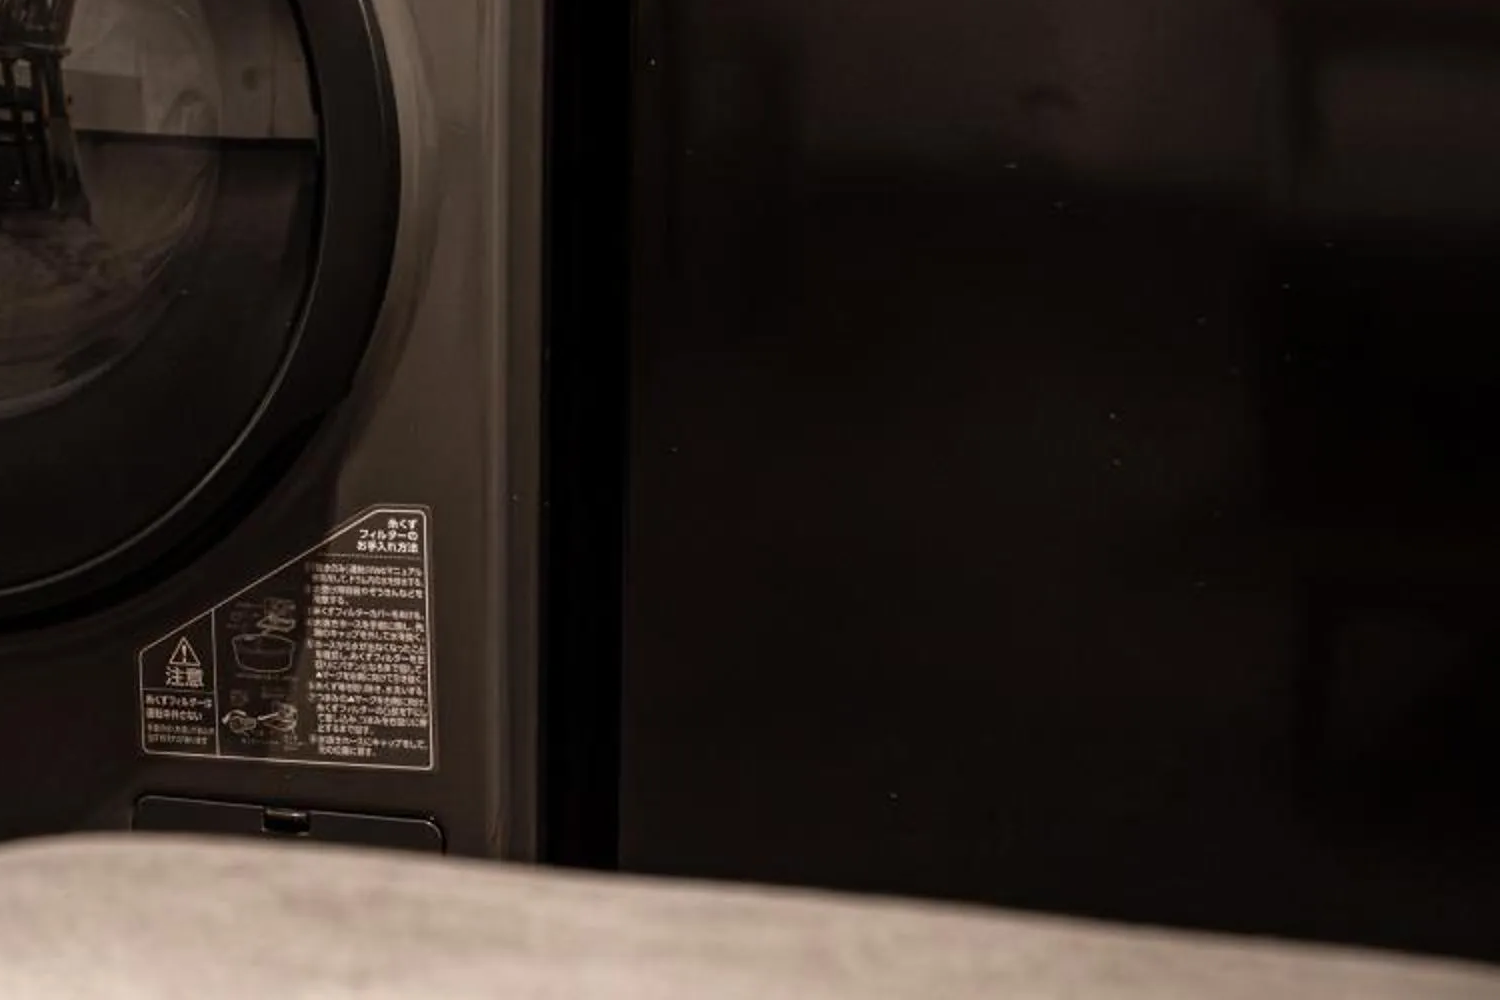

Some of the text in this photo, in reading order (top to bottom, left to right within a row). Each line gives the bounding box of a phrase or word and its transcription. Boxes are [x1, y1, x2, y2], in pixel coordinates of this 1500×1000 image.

[360, 529, 419, 541] フィルターの
[165, 666, 204, 688] 注意
